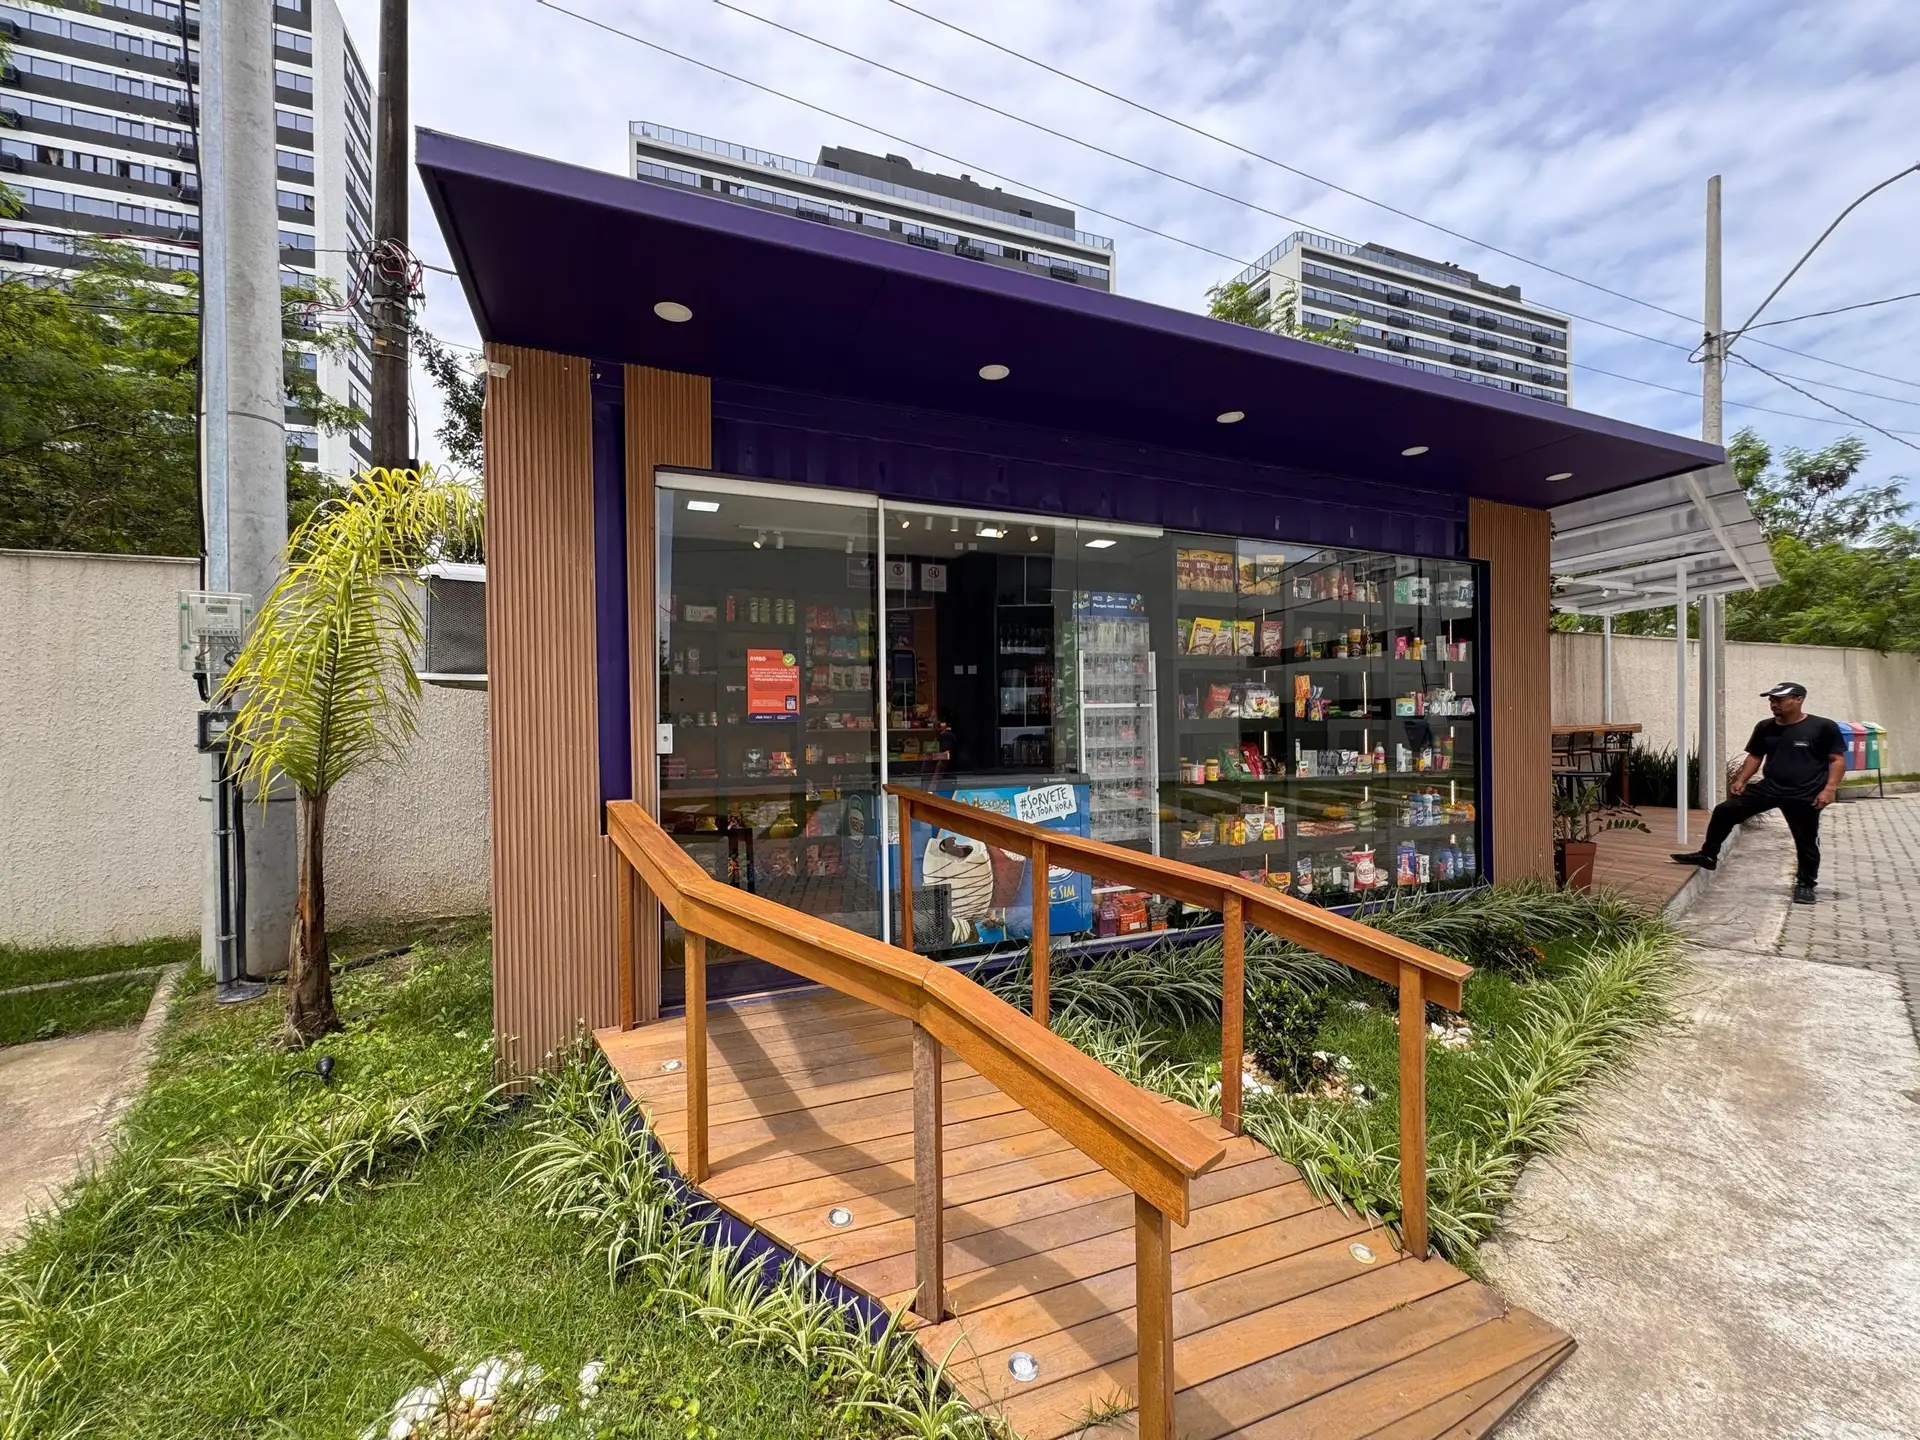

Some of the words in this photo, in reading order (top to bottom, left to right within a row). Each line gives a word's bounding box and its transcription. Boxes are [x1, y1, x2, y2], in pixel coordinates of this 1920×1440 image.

[1020, 787, 1067, 810] #SORVETE
[1021, 809, 1035, 821] PRA
[1036, 805, 1053, 816] TODA
[1055, 800, 1073, 812] HORA
[1059, 884, 1075, 899] SIM
